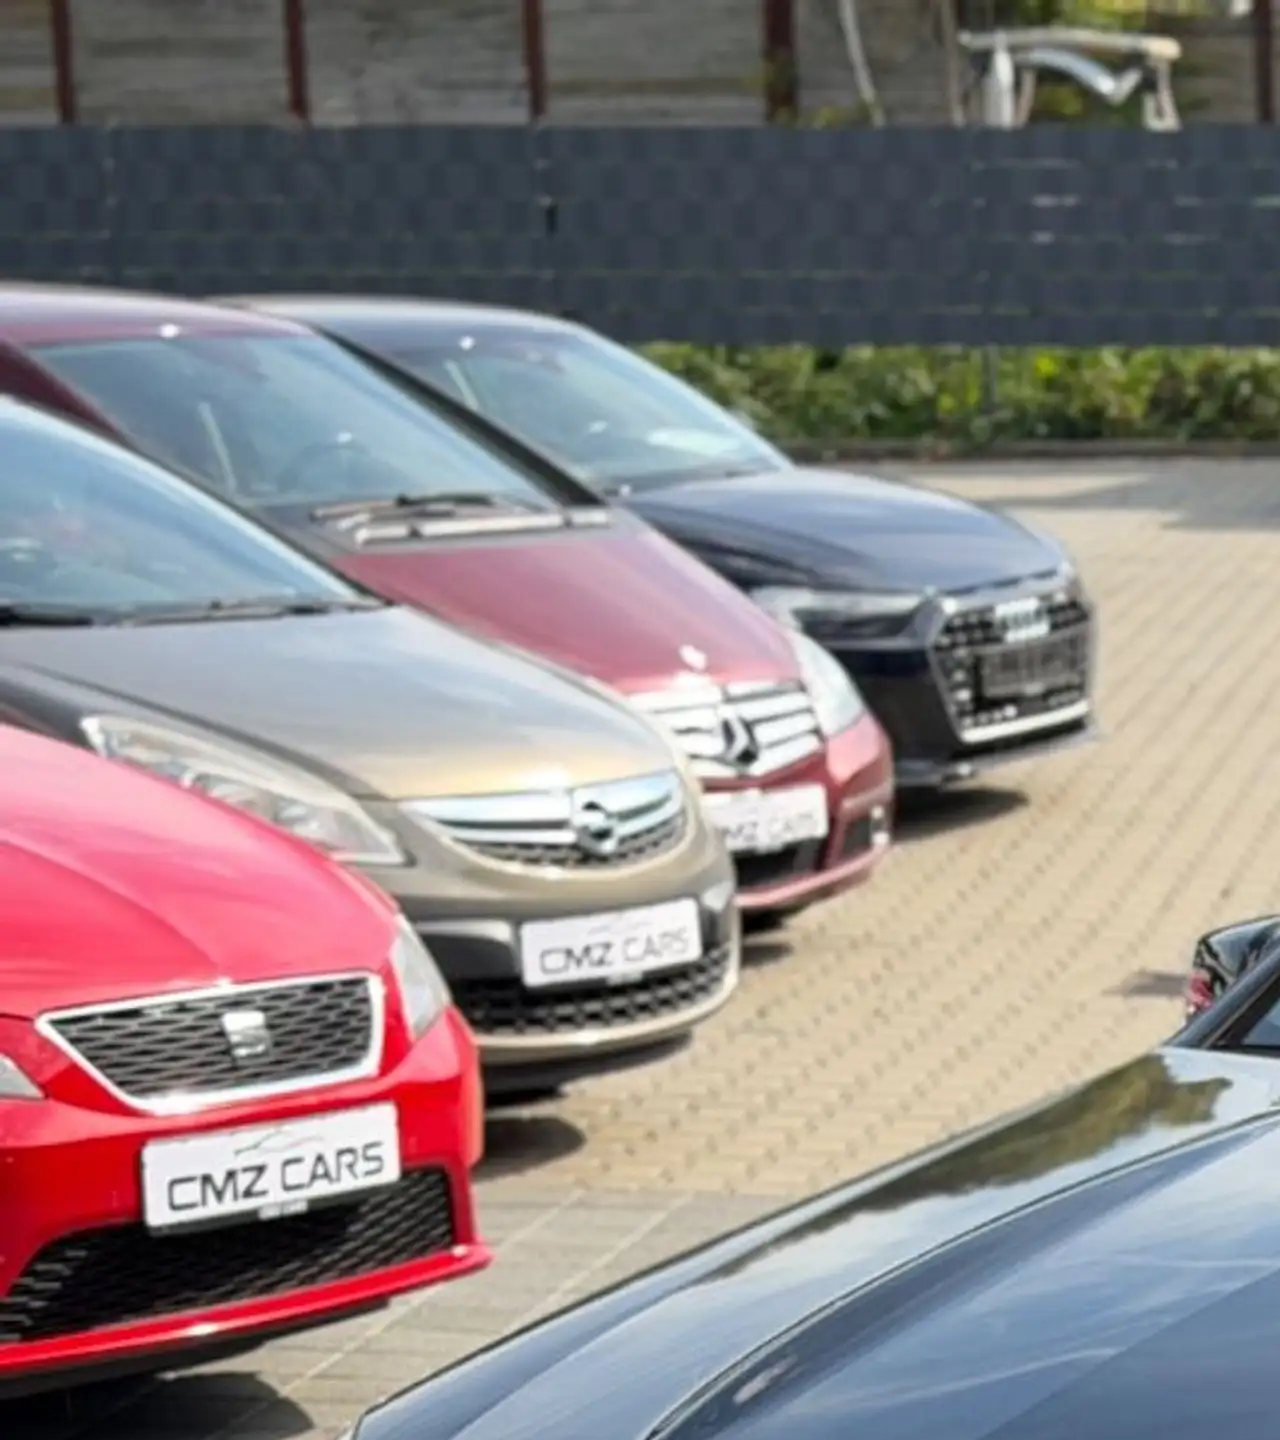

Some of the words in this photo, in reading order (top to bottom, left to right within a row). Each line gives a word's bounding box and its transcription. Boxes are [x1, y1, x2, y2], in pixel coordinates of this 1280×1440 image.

[539, 941, 615, 975] CMZ
[622, 927, 688, 962] CARS
[167, 1164, 268, 1211] CMZ
[280, 1140, 384, 1192] CARS
